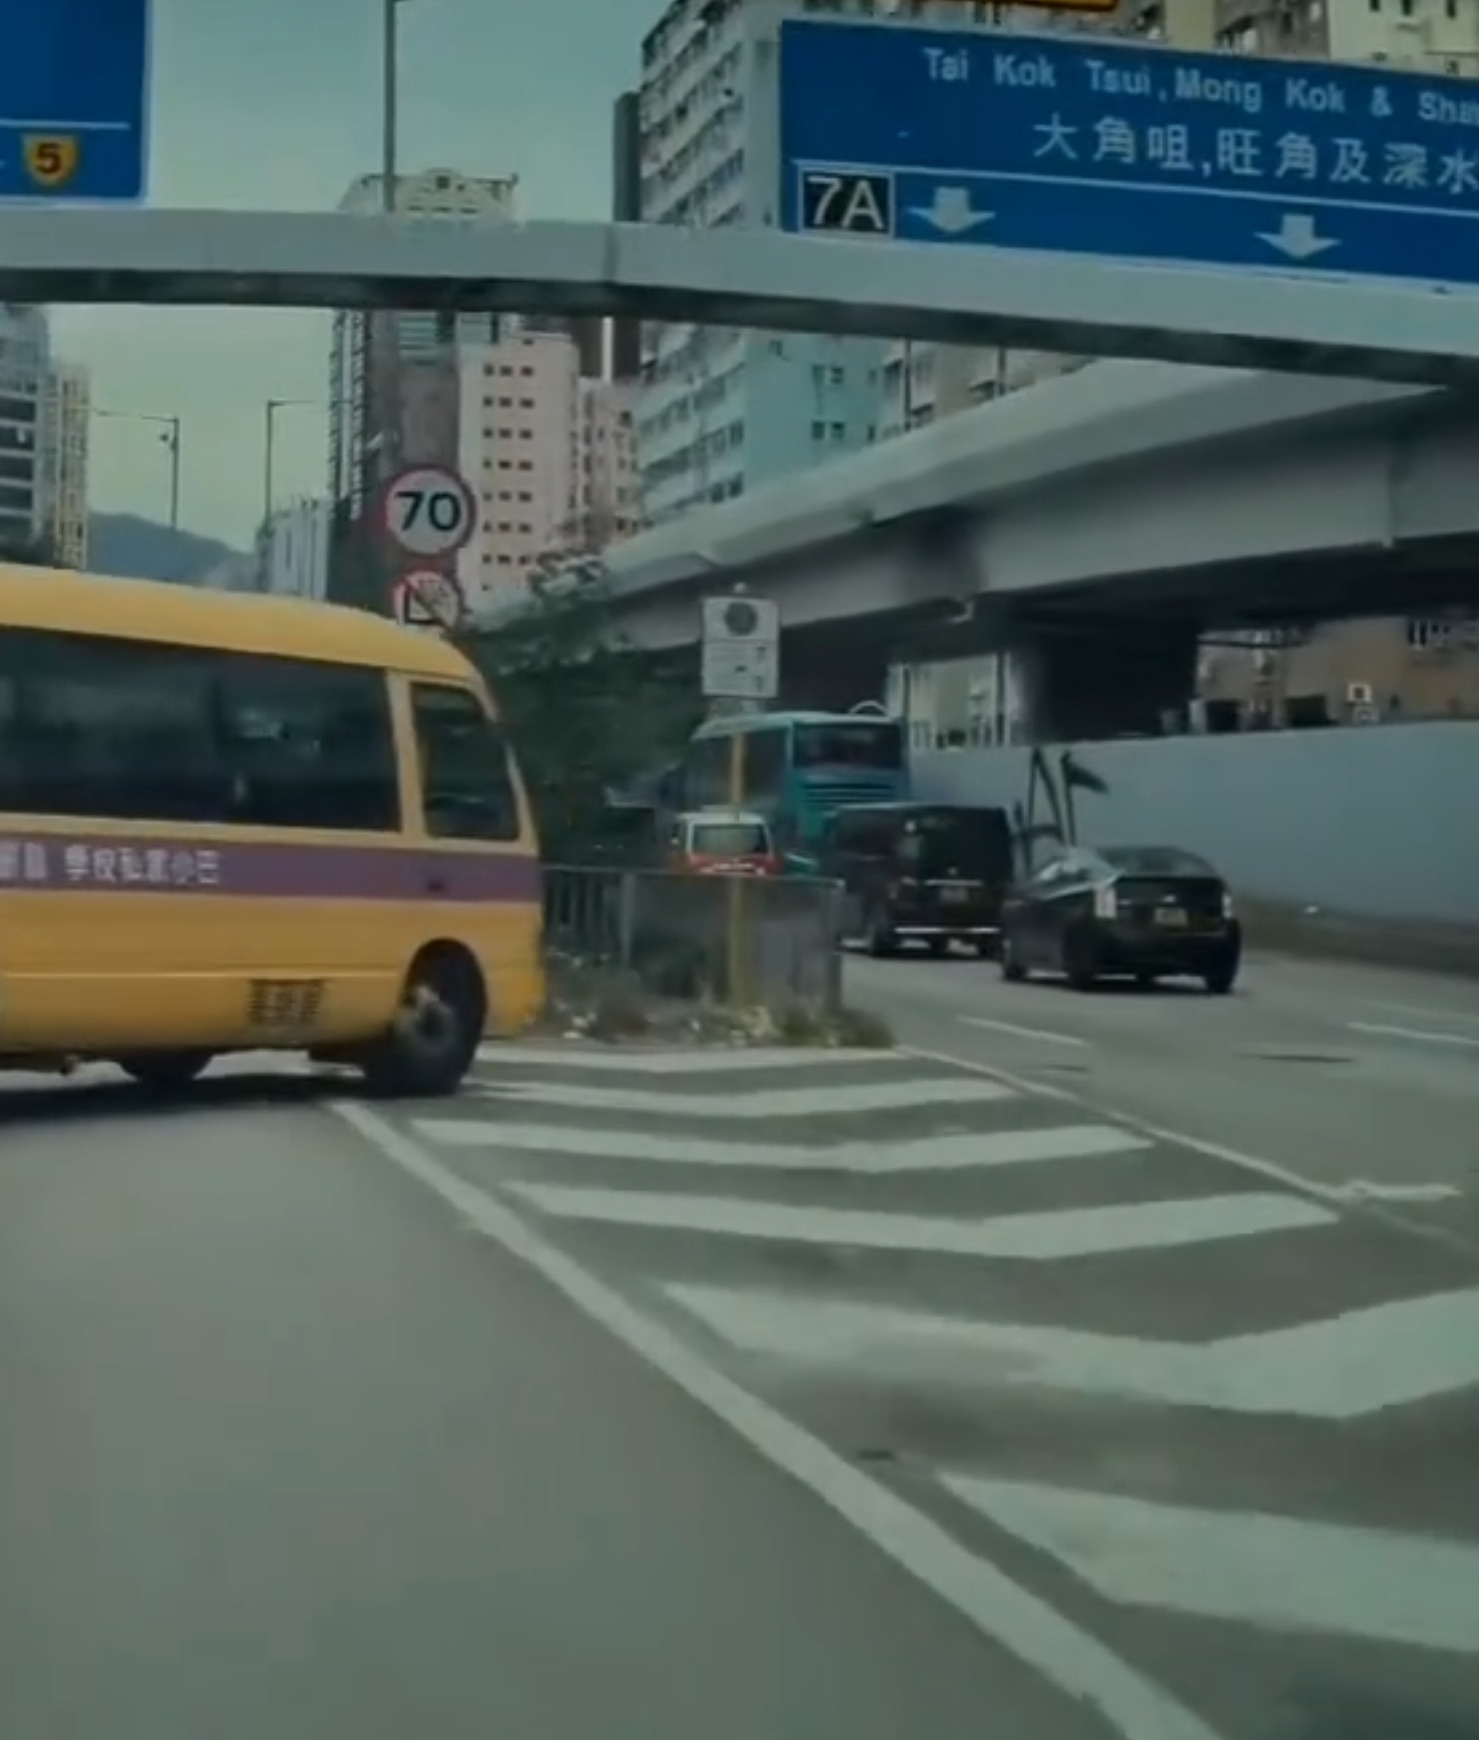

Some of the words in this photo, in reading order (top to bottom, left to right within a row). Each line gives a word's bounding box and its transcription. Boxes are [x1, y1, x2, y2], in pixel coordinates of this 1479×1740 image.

[923, 47, 969, 80] Tai
[994, 54, 1056, 88] Kok
[1286, 77, 1347, 113] Kok
[1371, 85, 1393, 118] &
[1418, 91, 1479, 127] Sha
[34, 142, 61, 174] 5
[807, 176, 885, 231] 7A
[397, 490, 461, 532] 70
